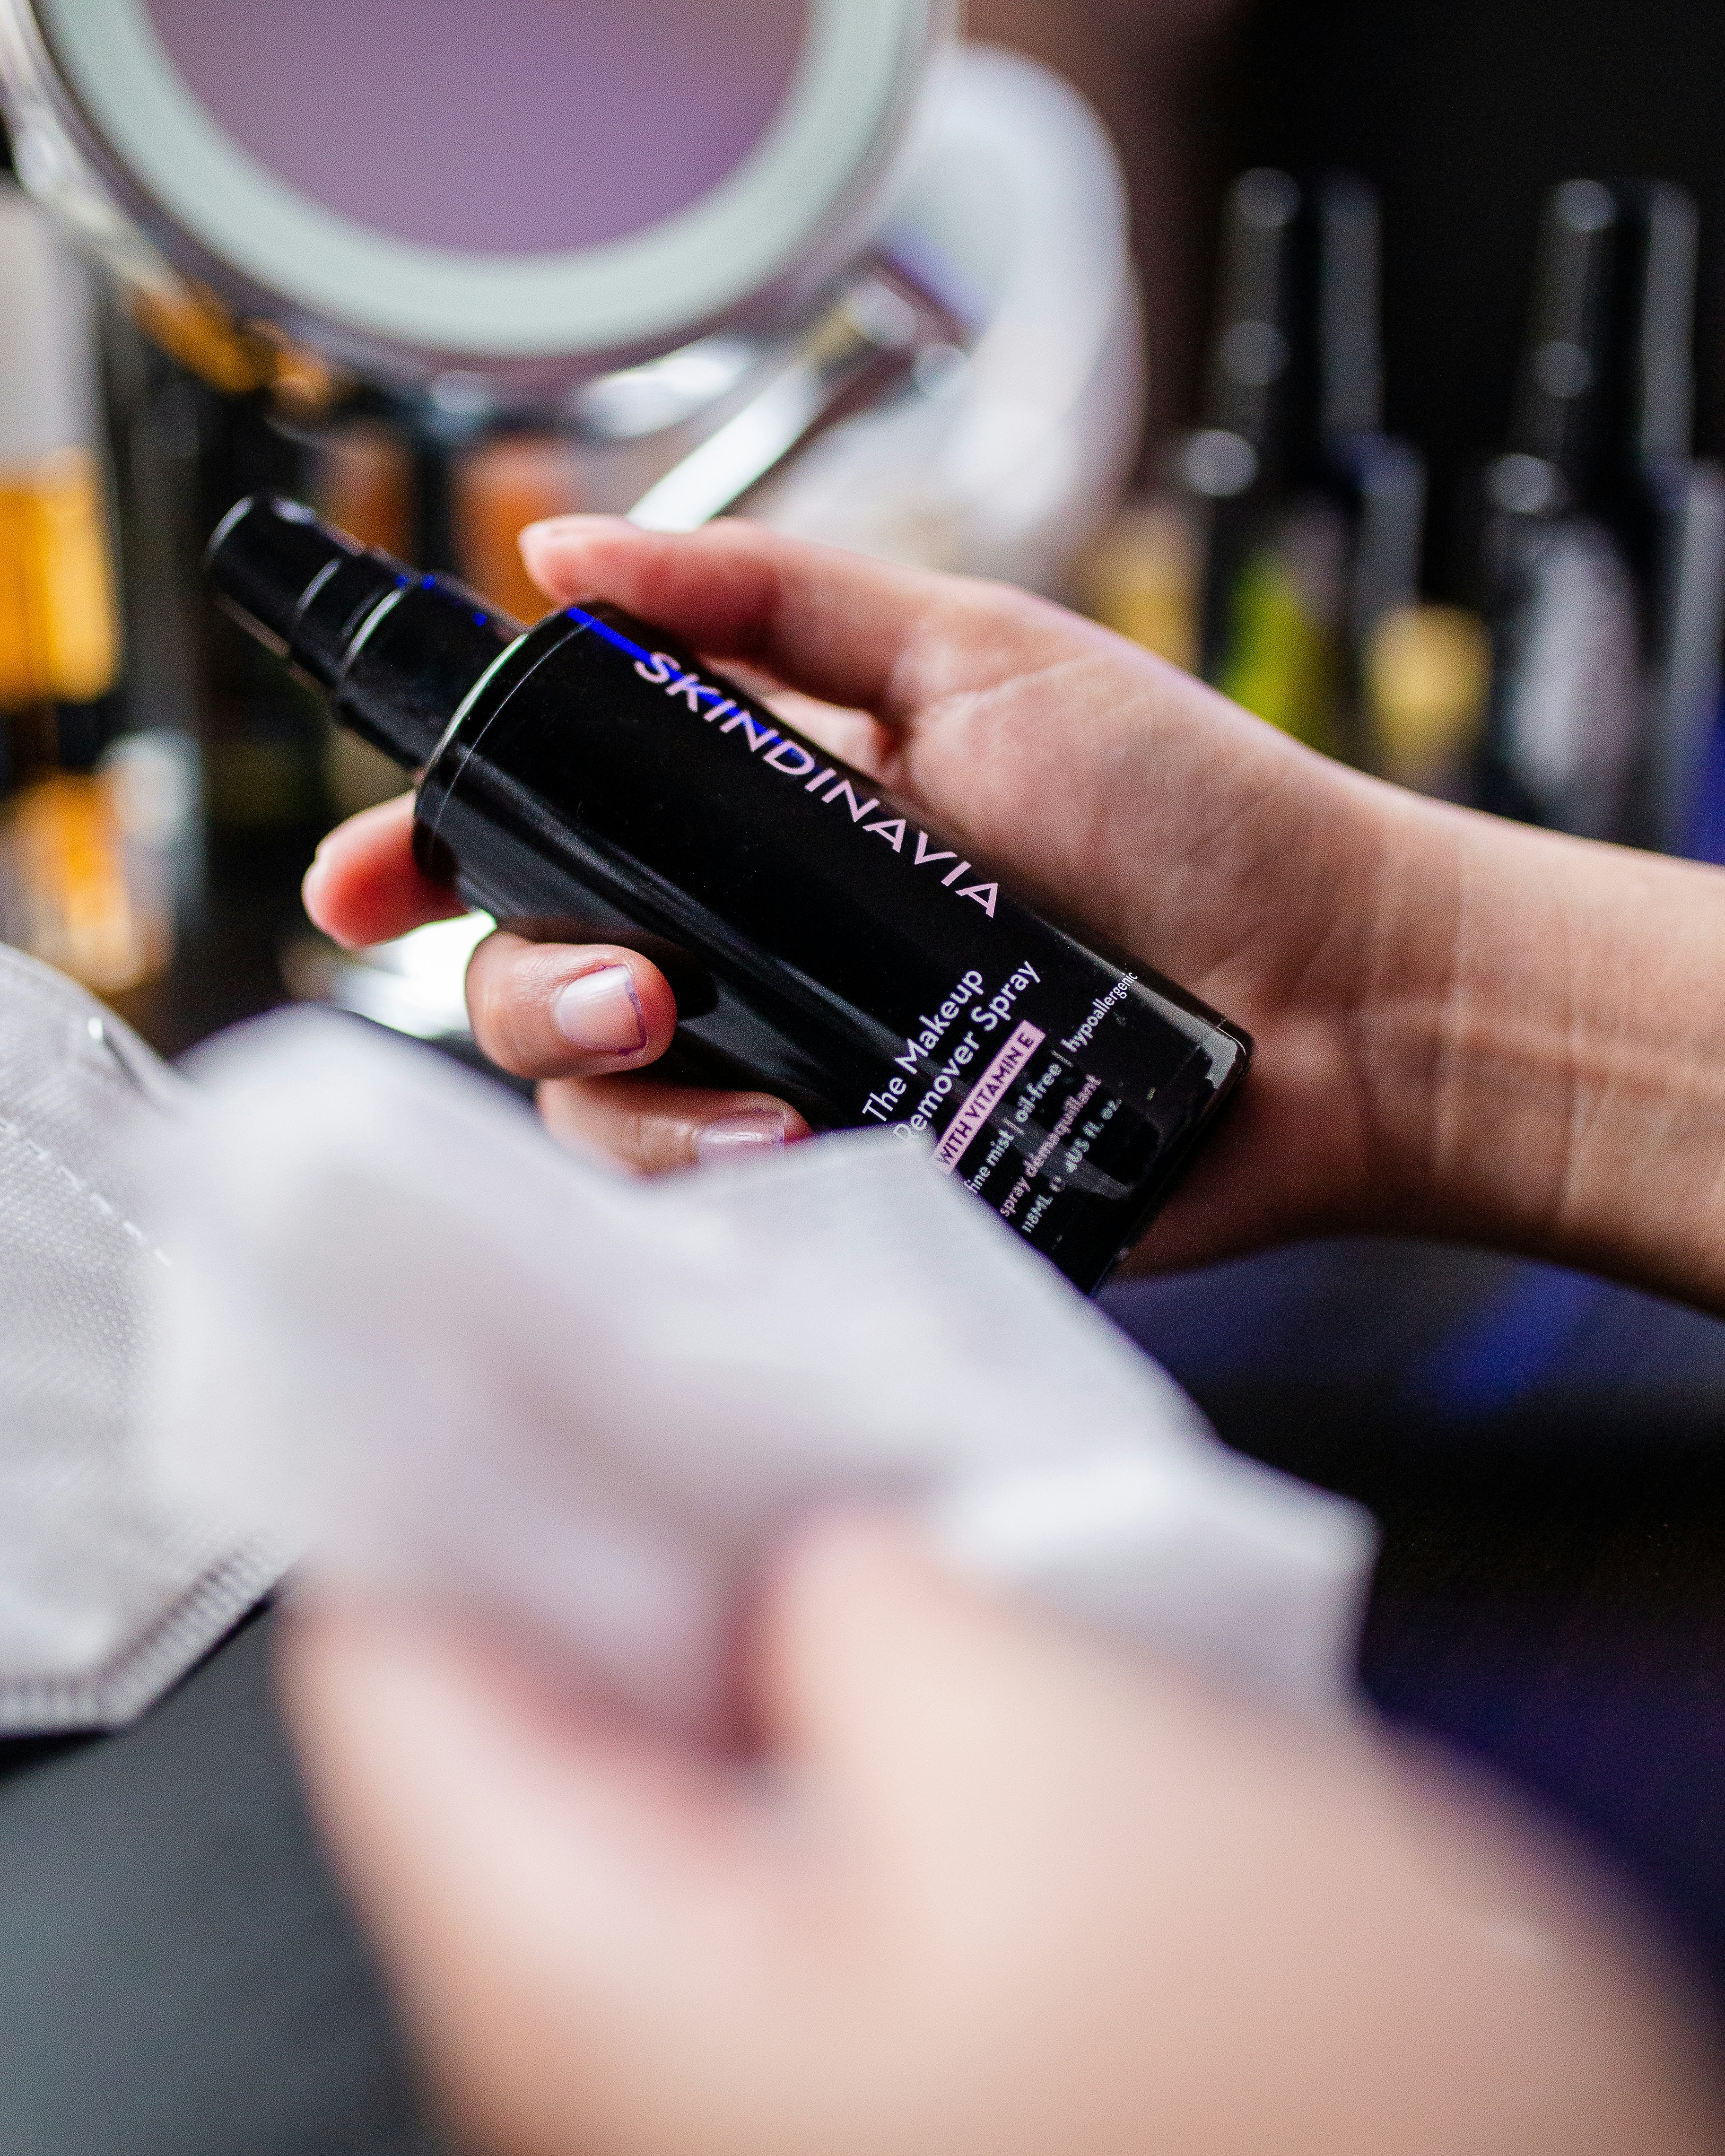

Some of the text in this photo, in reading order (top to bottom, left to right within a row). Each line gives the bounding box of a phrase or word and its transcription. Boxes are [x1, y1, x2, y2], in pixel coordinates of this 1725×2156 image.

[634, 652, 999, 918] SKINDINAVIA
[862, 971, 984, 1121] The Makeup
[971, 961, 1040, 1031] Spray
[937, 1032, 1034, 1165] WITH VITAMIN E
[964, 1166, 991, 1194] fine
[985, 1128, 1015, 1166] mist
[1015, 1063, 1062, 1123] oil-free
[1060, 972, 1138, 1053] hypoallergenic
[1000, 1176, 1031, 1217] spray
